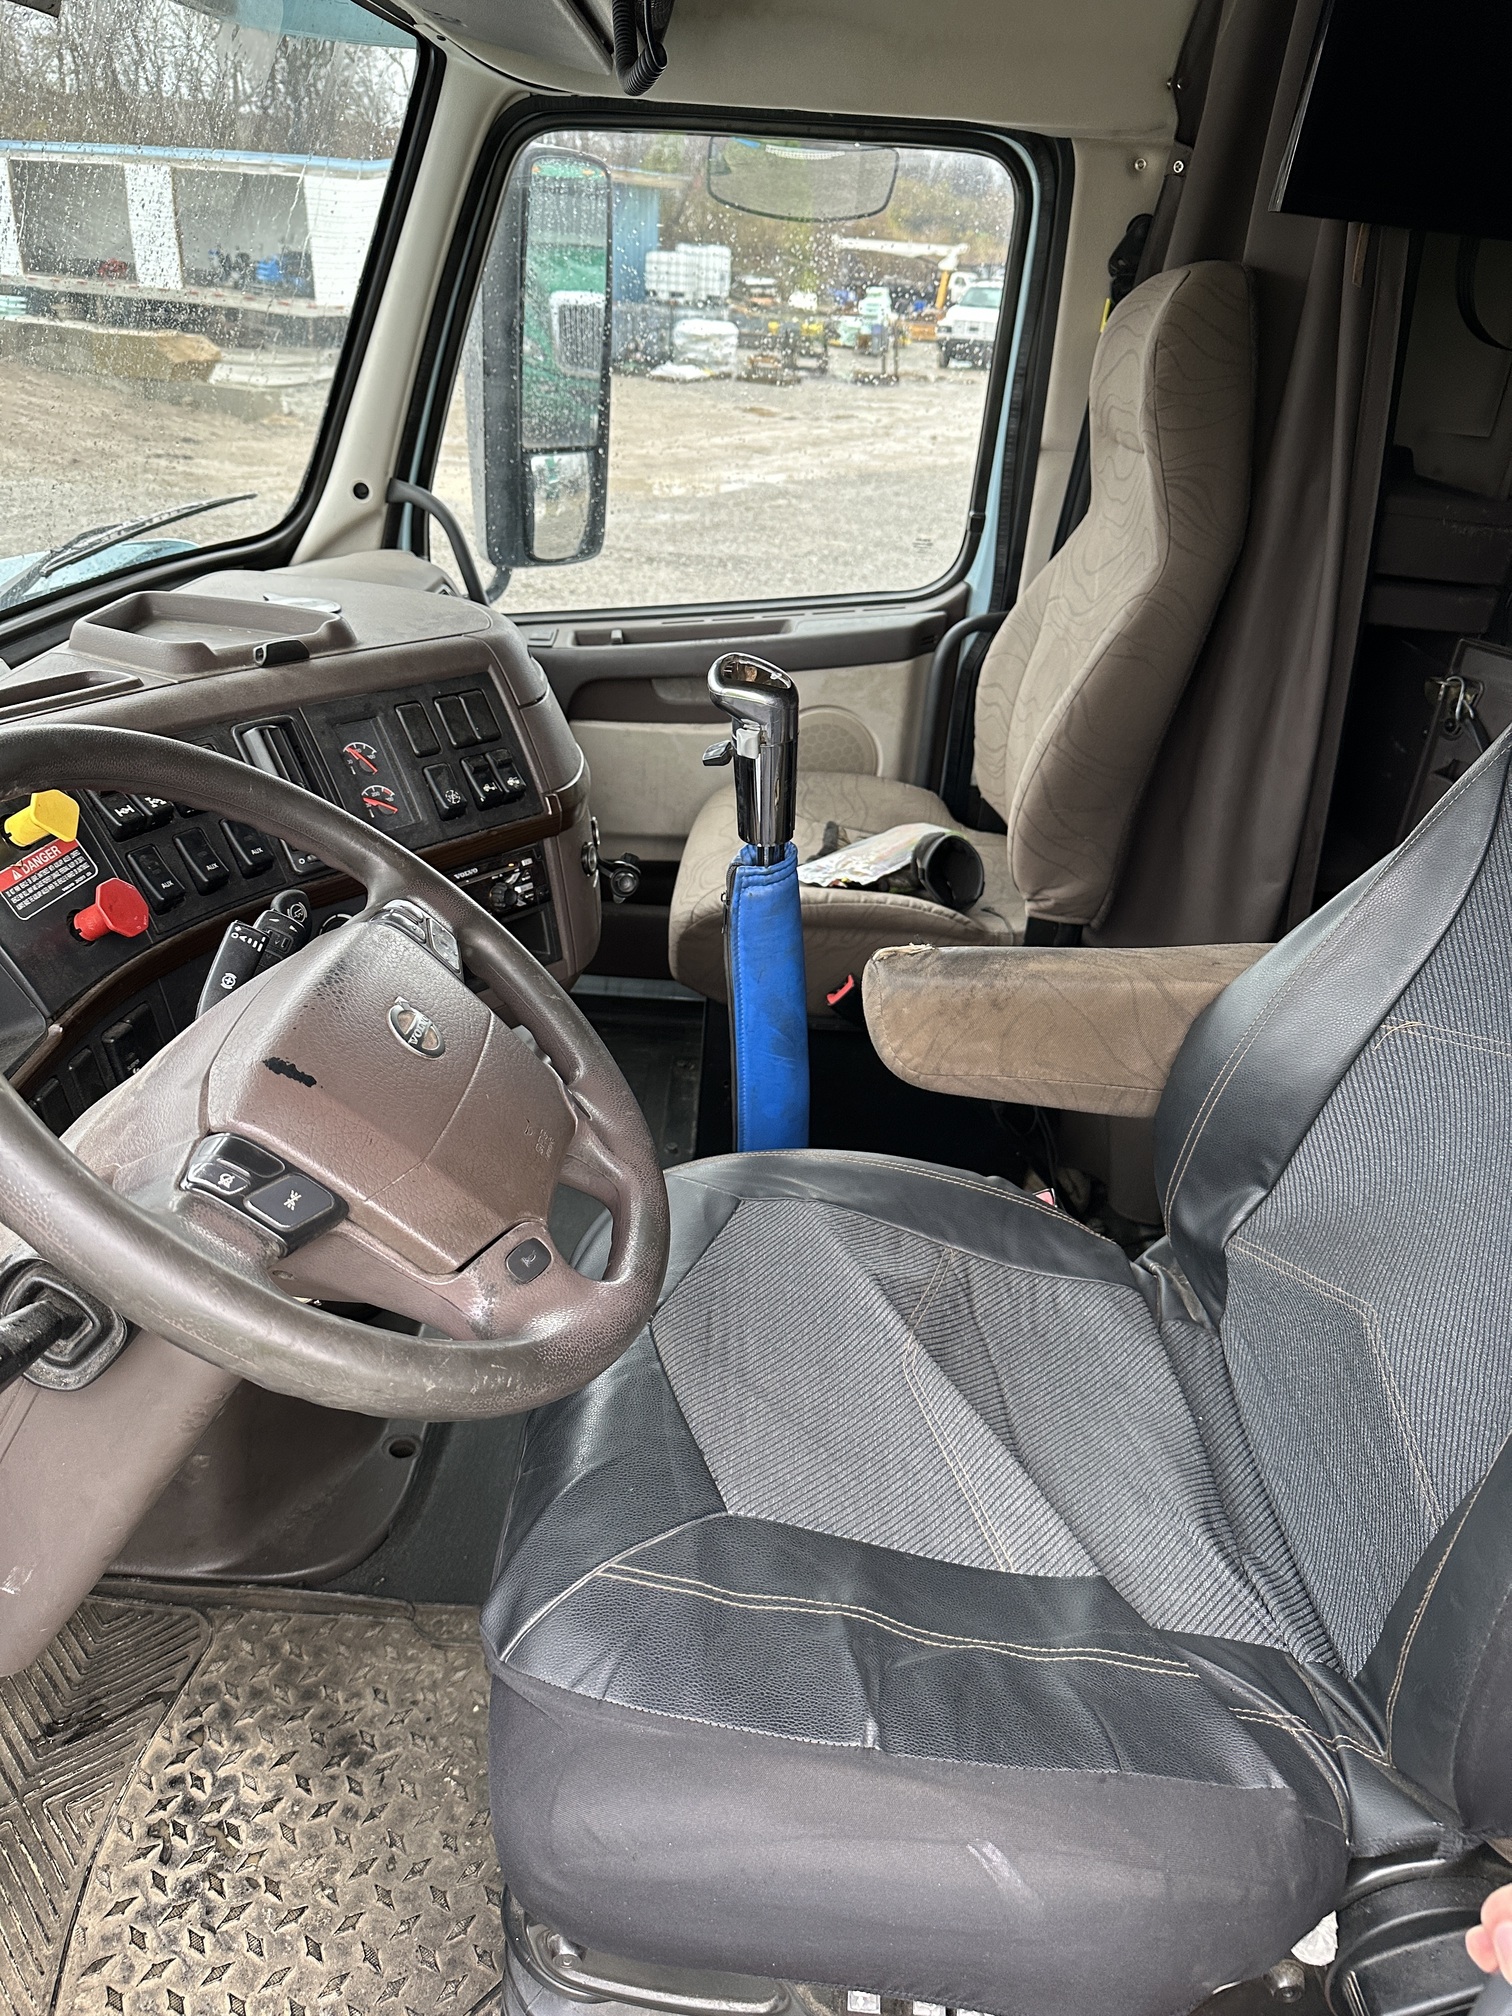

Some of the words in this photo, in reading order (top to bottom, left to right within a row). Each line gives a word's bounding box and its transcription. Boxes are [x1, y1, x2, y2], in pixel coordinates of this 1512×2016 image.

[251, 847, 264, 855] AUX
[20, 845, 62, 875] DANGER
[206, 863, 219, 871] AUX
[454, 867, 479, 879] VOLVO
[161, 880, 174, 889] AUX
[408, 1015, 431, 1045] VOLVO
